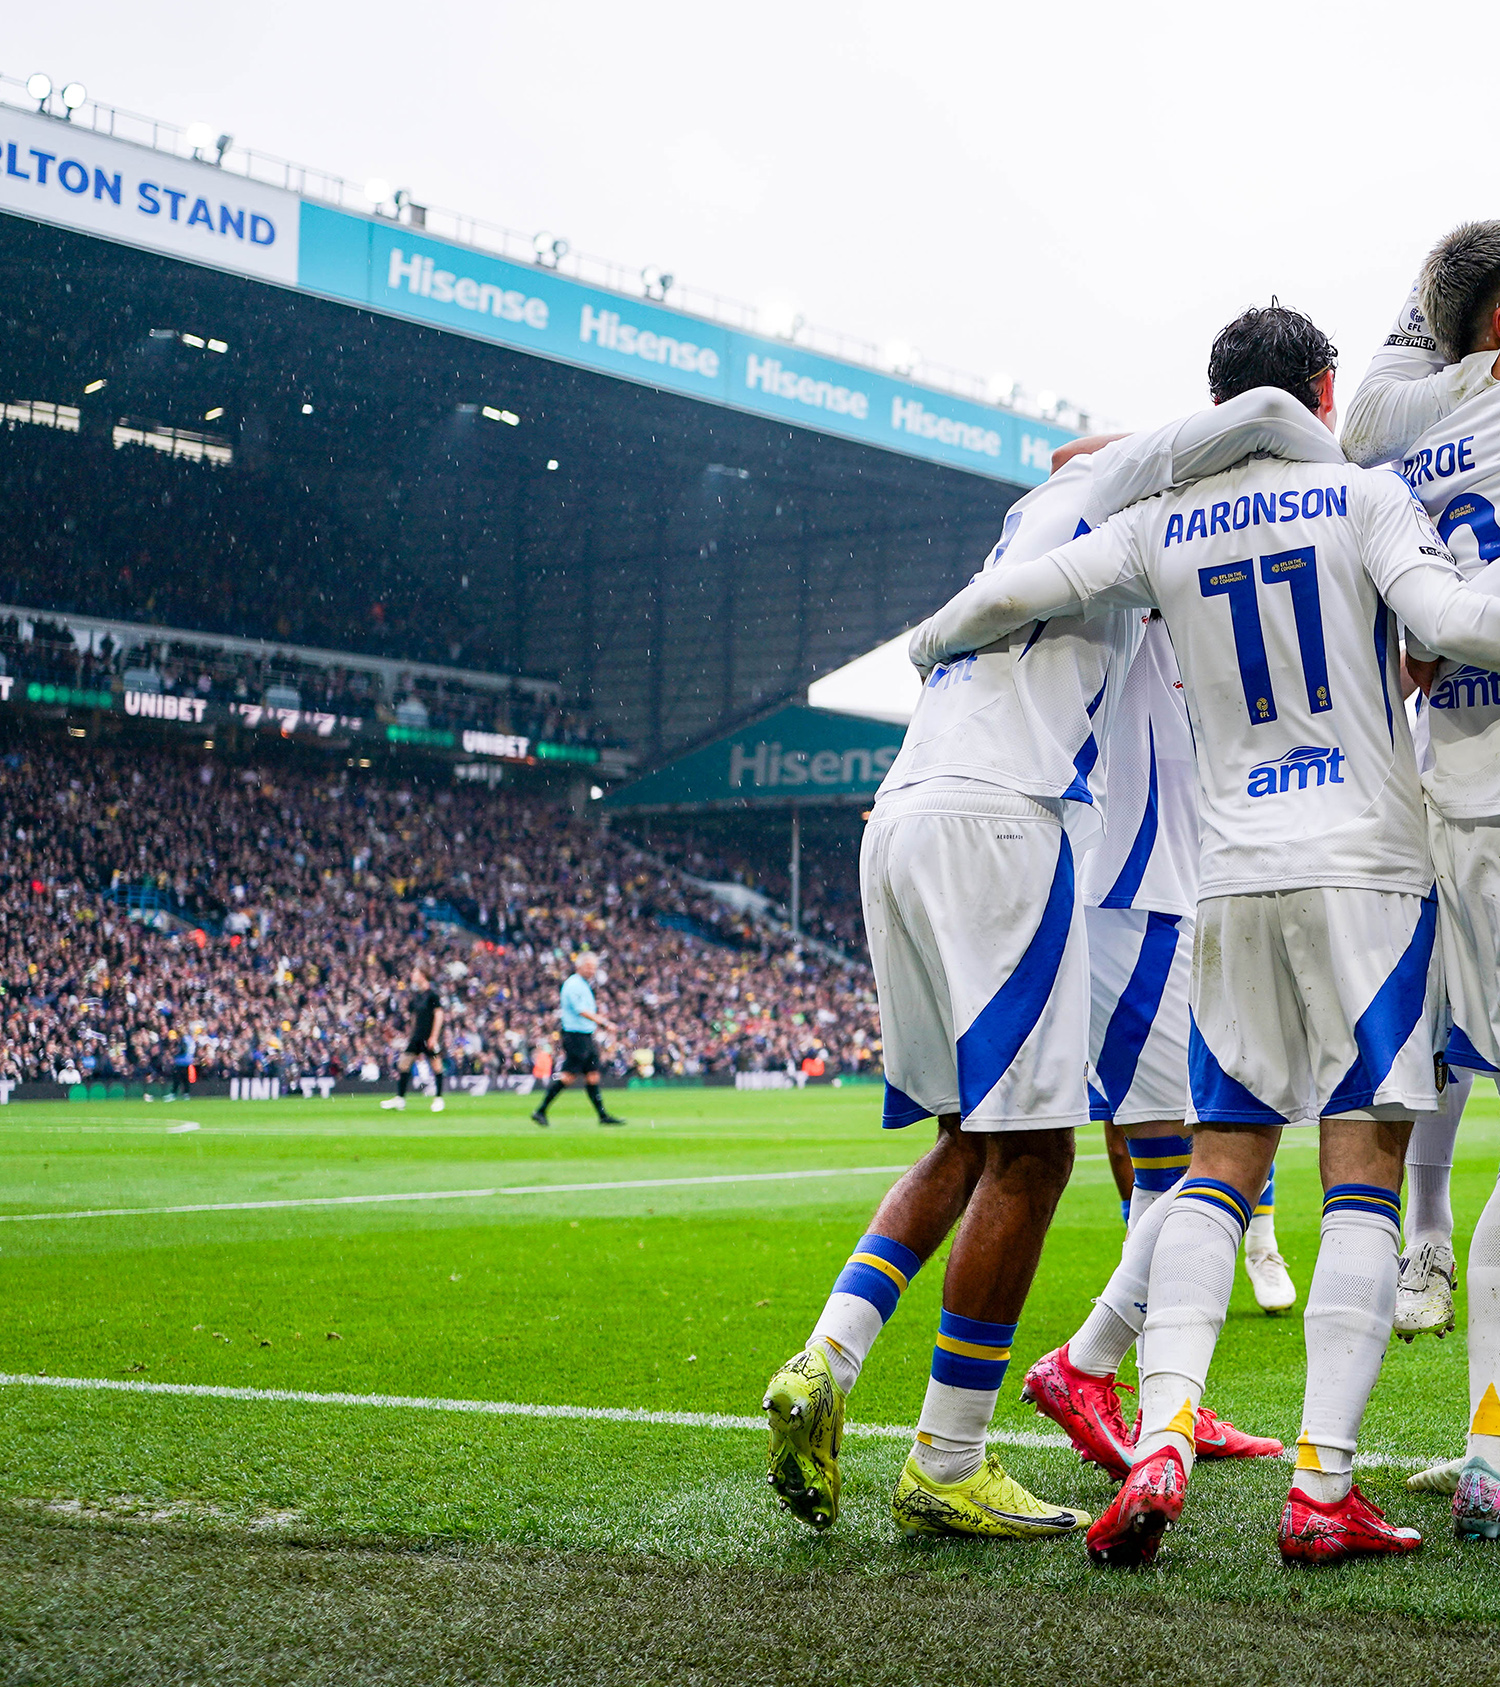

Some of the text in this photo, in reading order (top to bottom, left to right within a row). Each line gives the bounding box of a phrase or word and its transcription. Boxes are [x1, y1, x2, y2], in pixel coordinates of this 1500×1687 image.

[0, 142, 276, 246] LTON STAND
[388, 248, 550, 330] Hisense
[579, 303, 720, 379] Hisense
[1407, 322, 1422, 333] EFL
[745, 352, 869, 420] Hisense
[891, 395, 1000, 457] Hisense
[1164, 485, 1348, 548] AARONSON
[1197, 545, 1334, 726] 11
[124, 690, 207, 723] UNIBET
[728, 742, 900, 788] Hisens
[1246, 747, 1345, 798] amt
